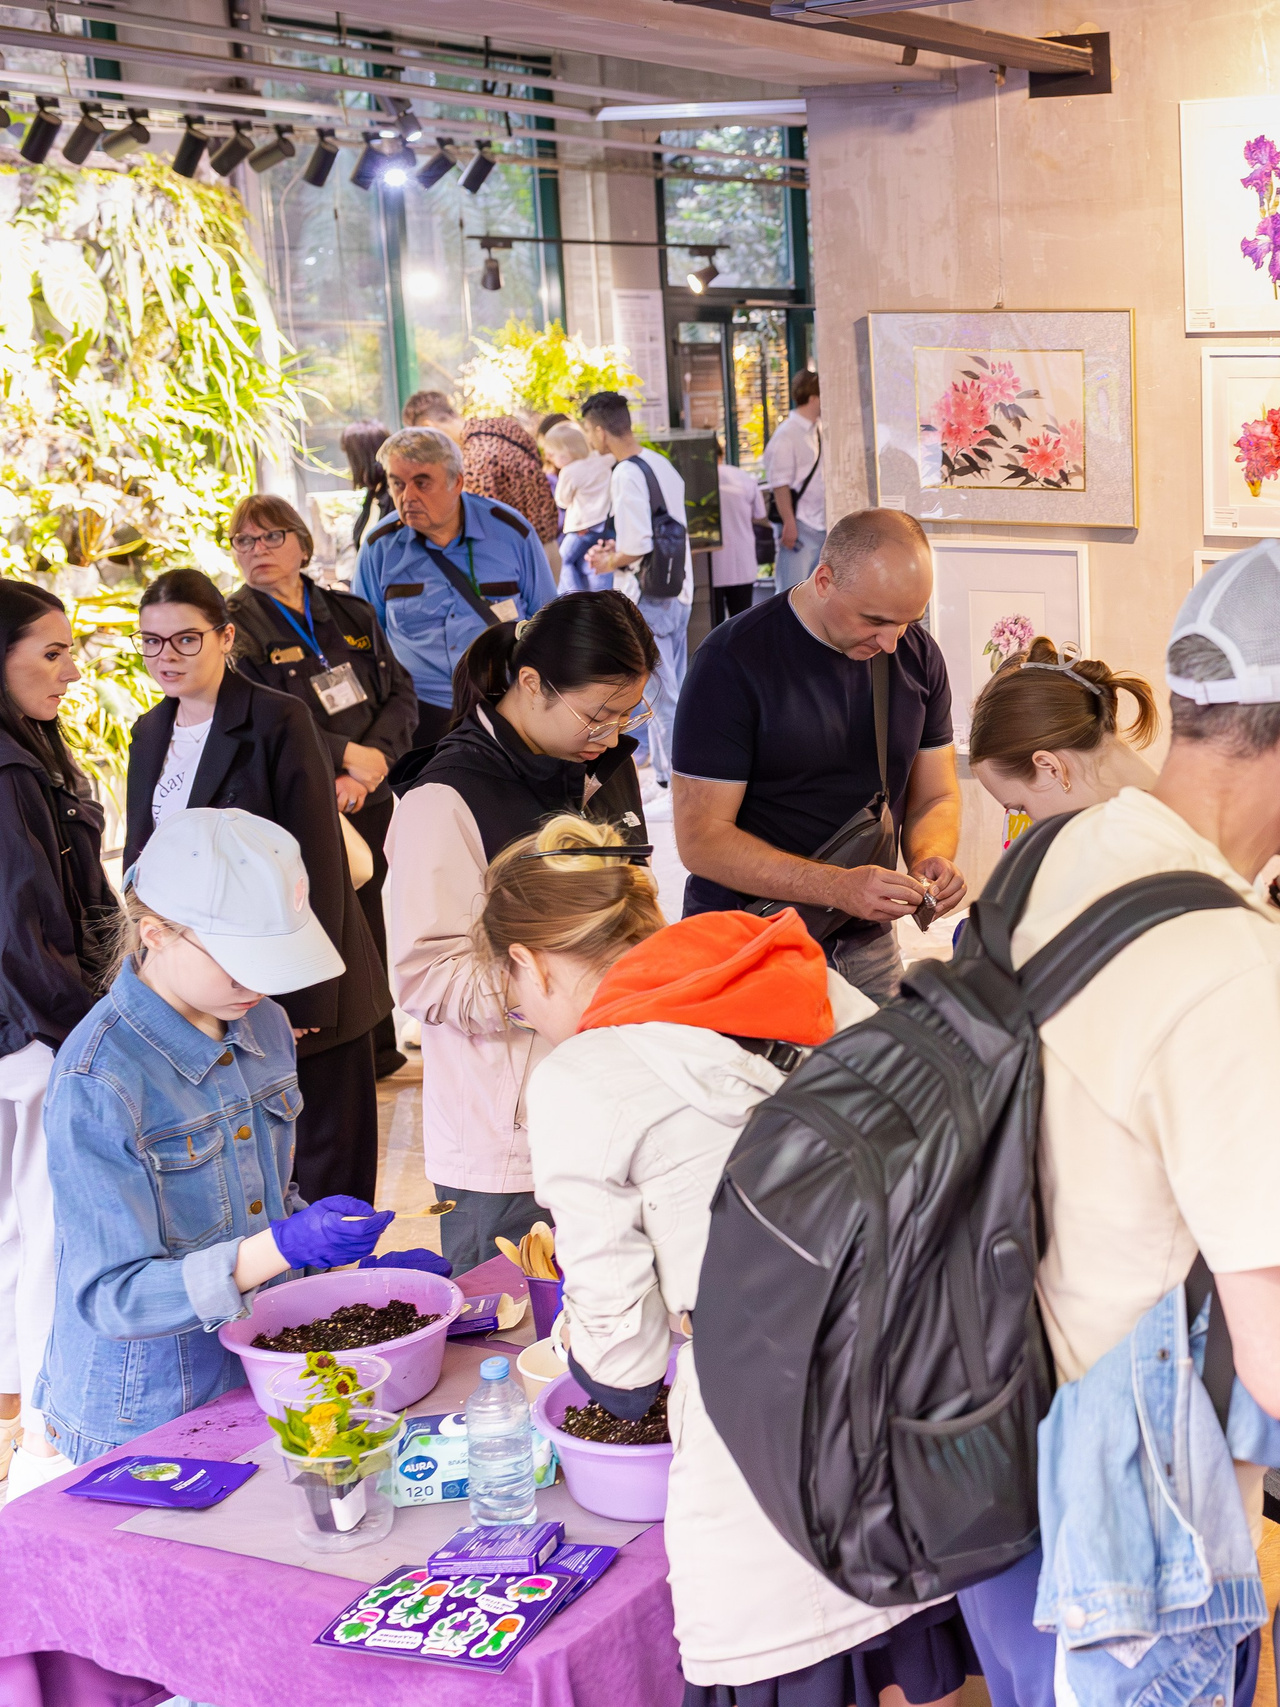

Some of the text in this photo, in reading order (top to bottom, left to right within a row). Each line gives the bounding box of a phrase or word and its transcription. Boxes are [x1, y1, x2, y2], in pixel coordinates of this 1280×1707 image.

[158, 771, 185, 798] day
[403, 1461, 435, 1473] AURA
[405, 1485, 434, 1498] 120
